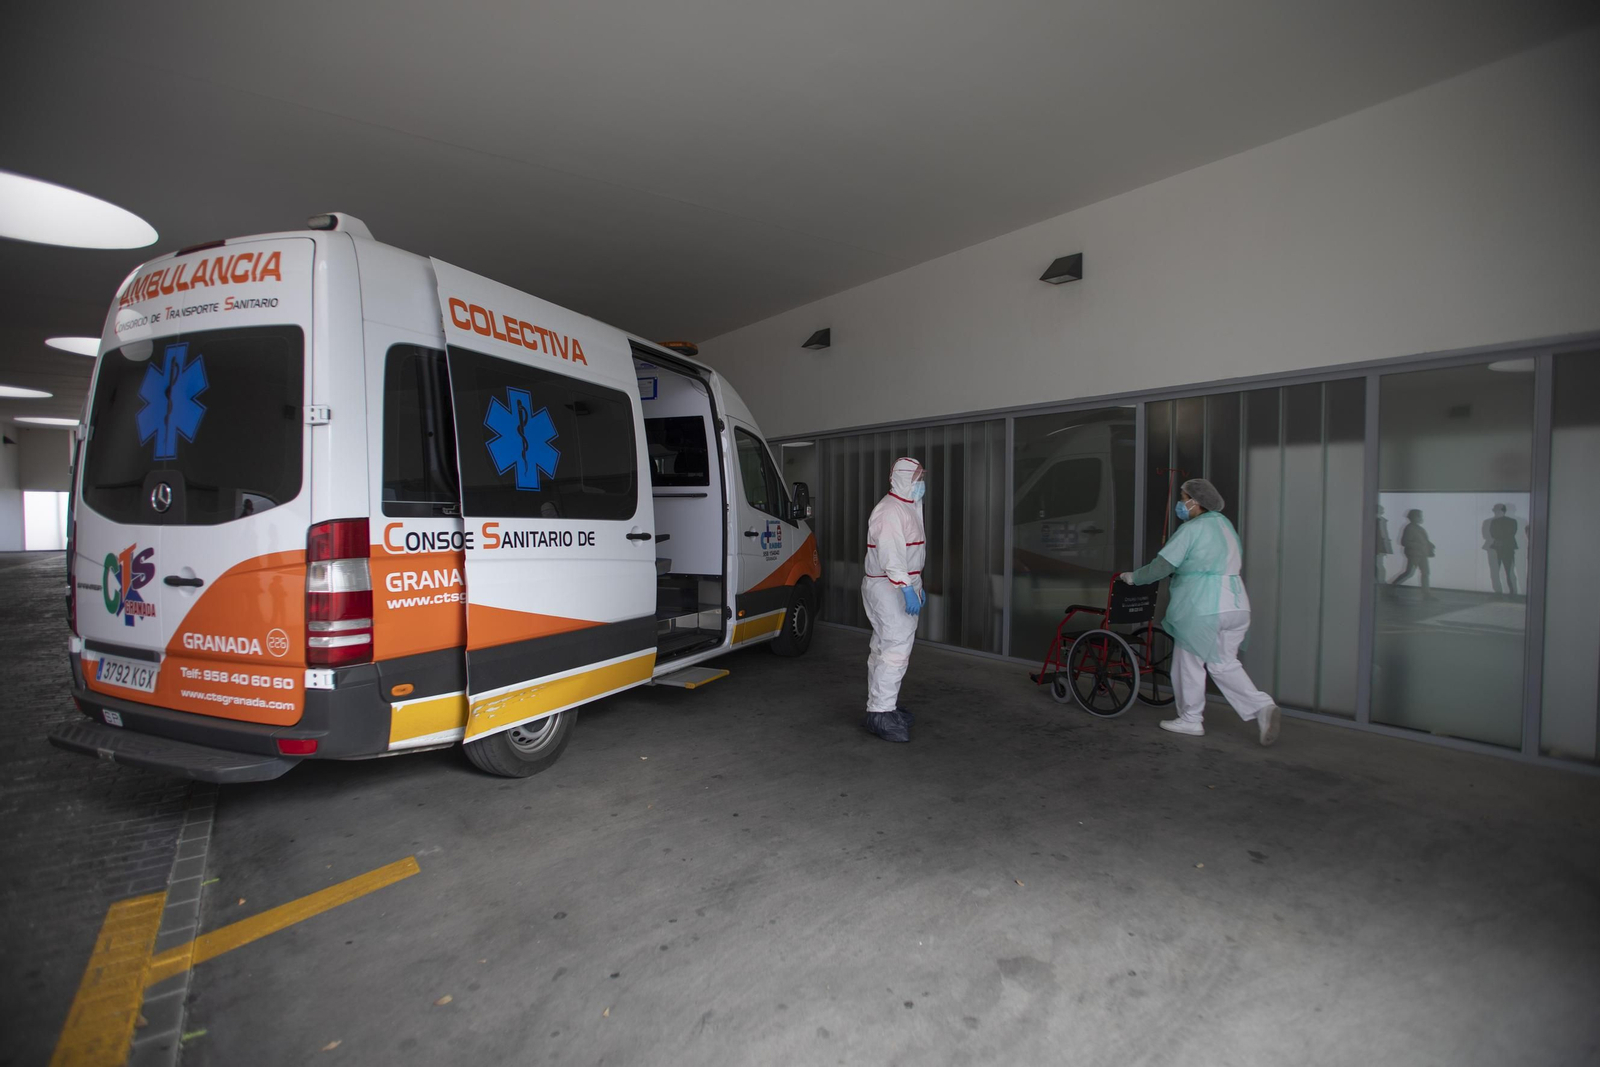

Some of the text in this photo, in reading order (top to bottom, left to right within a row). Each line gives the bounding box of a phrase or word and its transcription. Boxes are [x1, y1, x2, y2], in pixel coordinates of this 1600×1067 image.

[118, 251, 282, 311] AMBULANCIA
[114, 296, 279, 334] CONSORCIO DE TRANSPORTE SANITARIO
[448, 297, 588, 366] COLECTIVA
[481, 522, 573, 549] SANITARIO
[577, 531, 596, 547] DE
[103, 542, 156, 614] CTS
[125, 600, 156, 618] GRANADA
[183, 632, 263, 656] GRANADA
[268, 637, 288, 650] 226
[103, 662, 155, 690] 3792 KGX
[180, 666, 202, 680] Telf:
[203, 670, 229, 683] 958
[230, 673, 249, 685] 40
[251, 675, 271, 687] 60
[181, 689, 295, 711] www.ctsgranada.com
